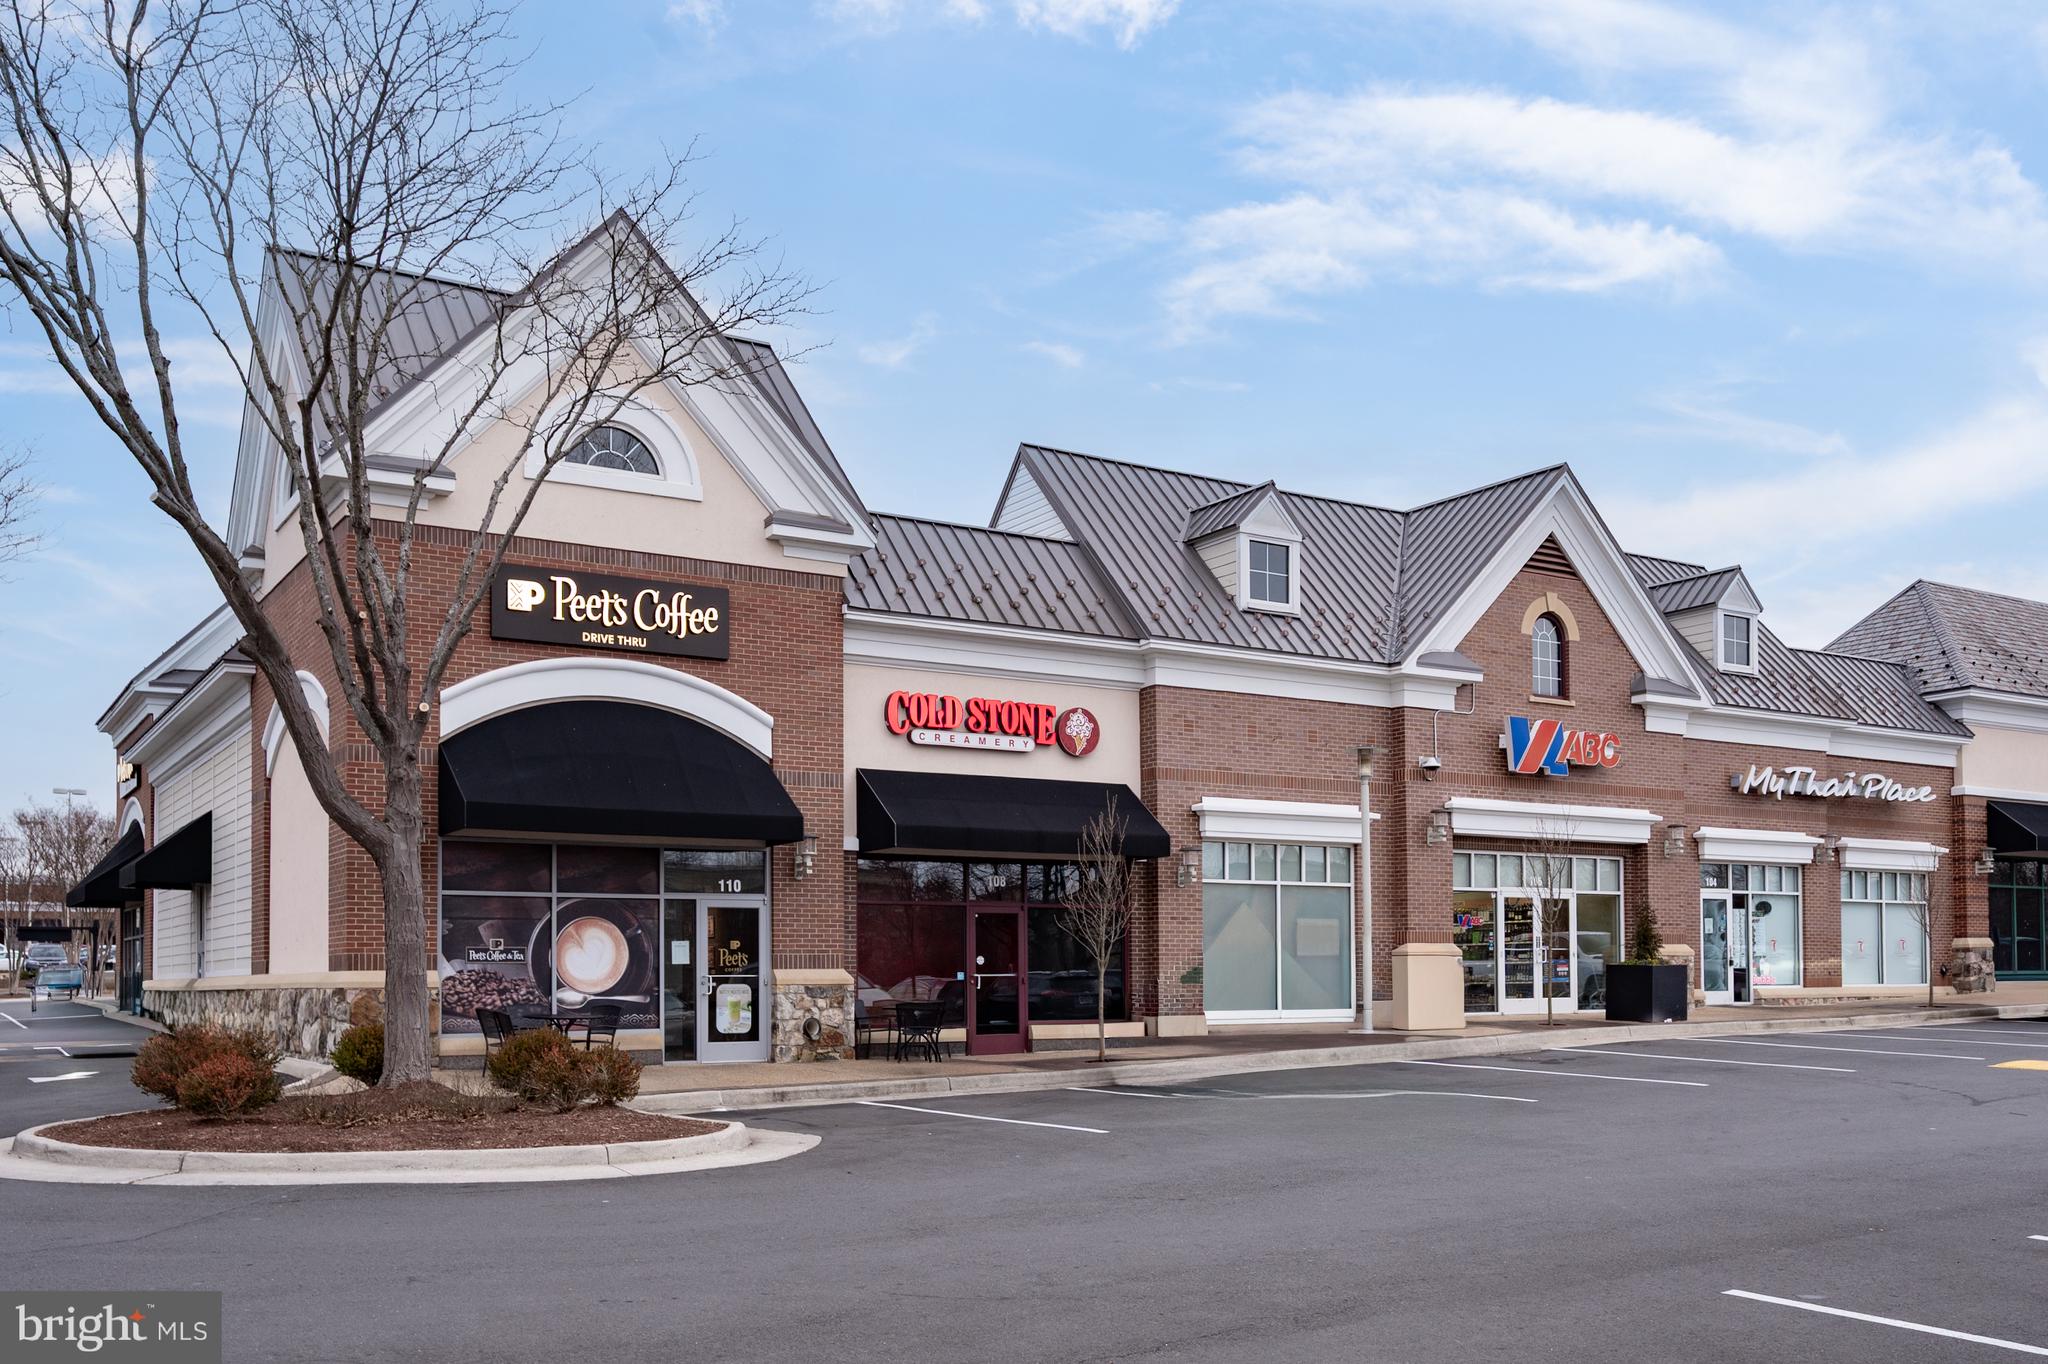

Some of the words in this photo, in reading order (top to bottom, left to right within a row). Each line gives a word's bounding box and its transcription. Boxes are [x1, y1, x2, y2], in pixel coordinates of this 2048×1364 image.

[549, 576, 628, 627] Peet's
[633, 588, 719, 639] Coffee
[582, 631, 615, 645] DRIVE
[617, 634, 647, 648] THRU
[886, 690, 964, 735] COLD
[965, 696, 1057, 746] STONE
[918, 732, 1030, 749] CREAMERY
[1555, 730, 1621, 768] ABC
[1742, 764, 1785, 801] My
[1781, 766, 1856, 797] Thai
[1859, 773, 1937, 802] Place
[718, 879, 742, 893] 110
[988, 875, 1006, 888] 108
[1705, 877, 1717, 887] 104
[486, 950, 506, 962] Coffee
[511, 950, 525, 961] Tea
